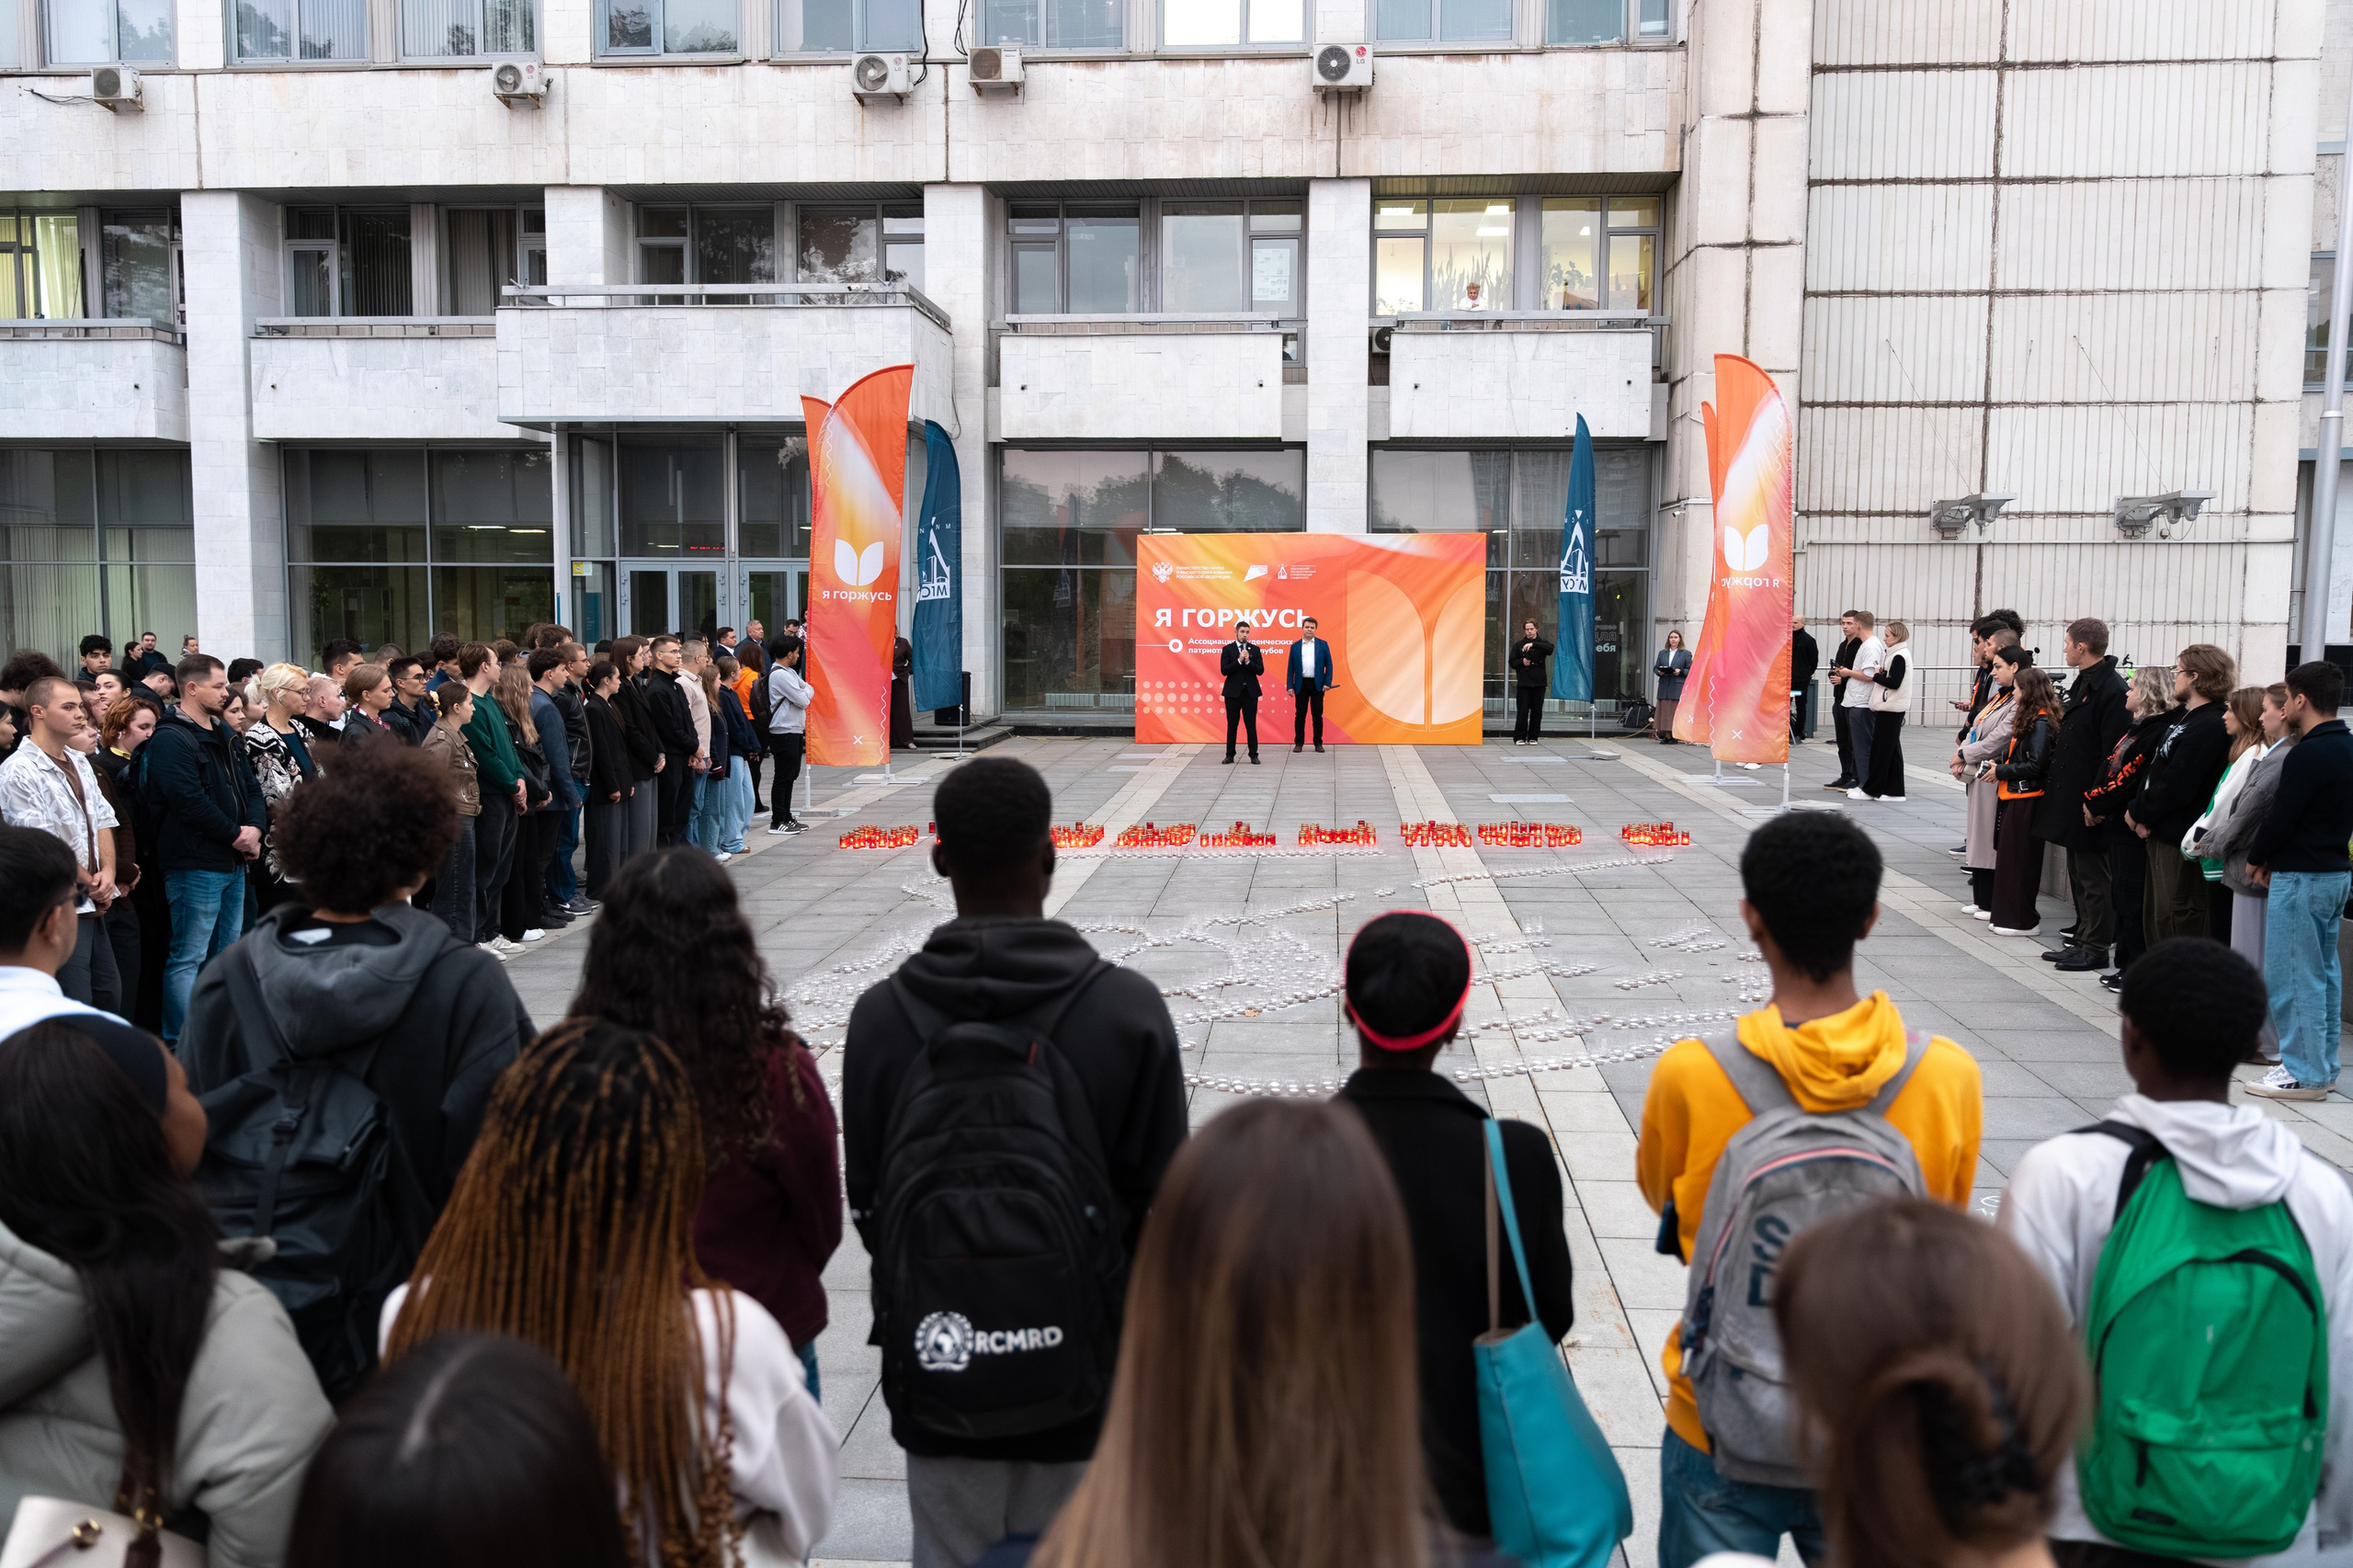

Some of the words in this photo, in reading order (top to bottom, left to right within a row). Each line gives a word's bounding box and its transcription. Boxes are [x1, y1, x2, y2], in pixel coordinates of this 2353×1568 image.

[833, 590, 892, 603] горжусь
[1154, 608, 1172, 628] Я
[1182, 608, 1311, 629] ГОРЖУСЬ
[1260, 646, 1284, 655] лубов
[1596, 642, 1617, 653] ебя
[974, 1325, 1063, 1354] RCMRD
